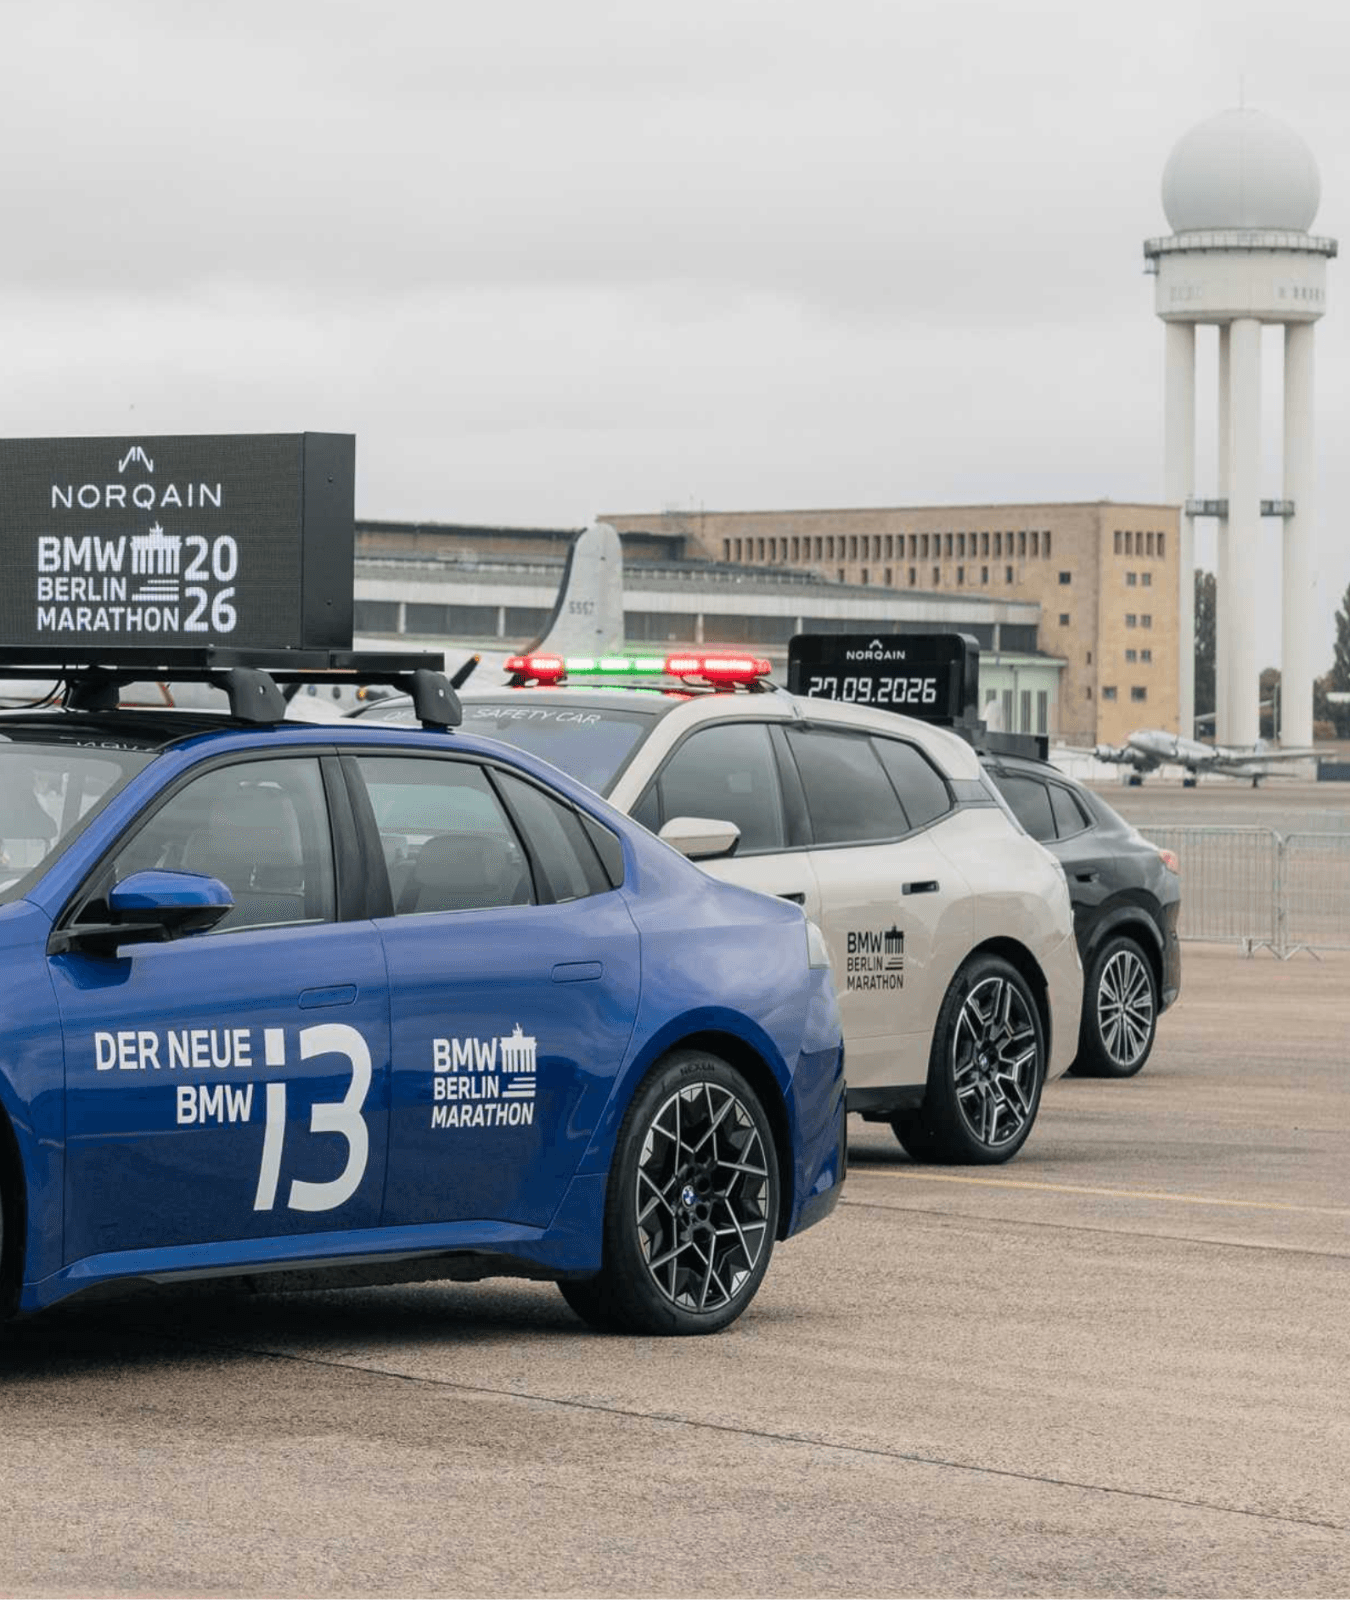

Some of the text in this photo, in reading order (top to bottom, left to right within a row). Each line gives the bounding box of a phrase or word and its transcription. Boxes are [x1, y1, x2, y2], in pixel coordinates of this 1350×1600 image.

[52, 483, 221, 510] NORQAIN
[38, 536, 126, 572] BMW
[185, 535, 238, 581] 20
[37, 577, 126, 601] BERLIN
[37, 607, 179, 632] MARATHON
[184, 587, 237, 633] 26
[846, 651, 906, 660] NORQAIN
[808, 677, 937, 703] 27.09.2026
[473, 708, 552, 721] SAFETY
[555, 712, 601, 724] CAR
[847, 931, 883, 954] BMW
[847, 956, 883, 972] BERLIN
[847, 974, 904, 990] MARATHON
[95, 1029, 252, 1071] DER NEUE
[433, 1038, 497, 1073] BMW
[433, 1077, 499, 1100] BERLIN
[176, 1084, 253, 1124] BMW
[431, 1103, 535, 1128] MARATHON
